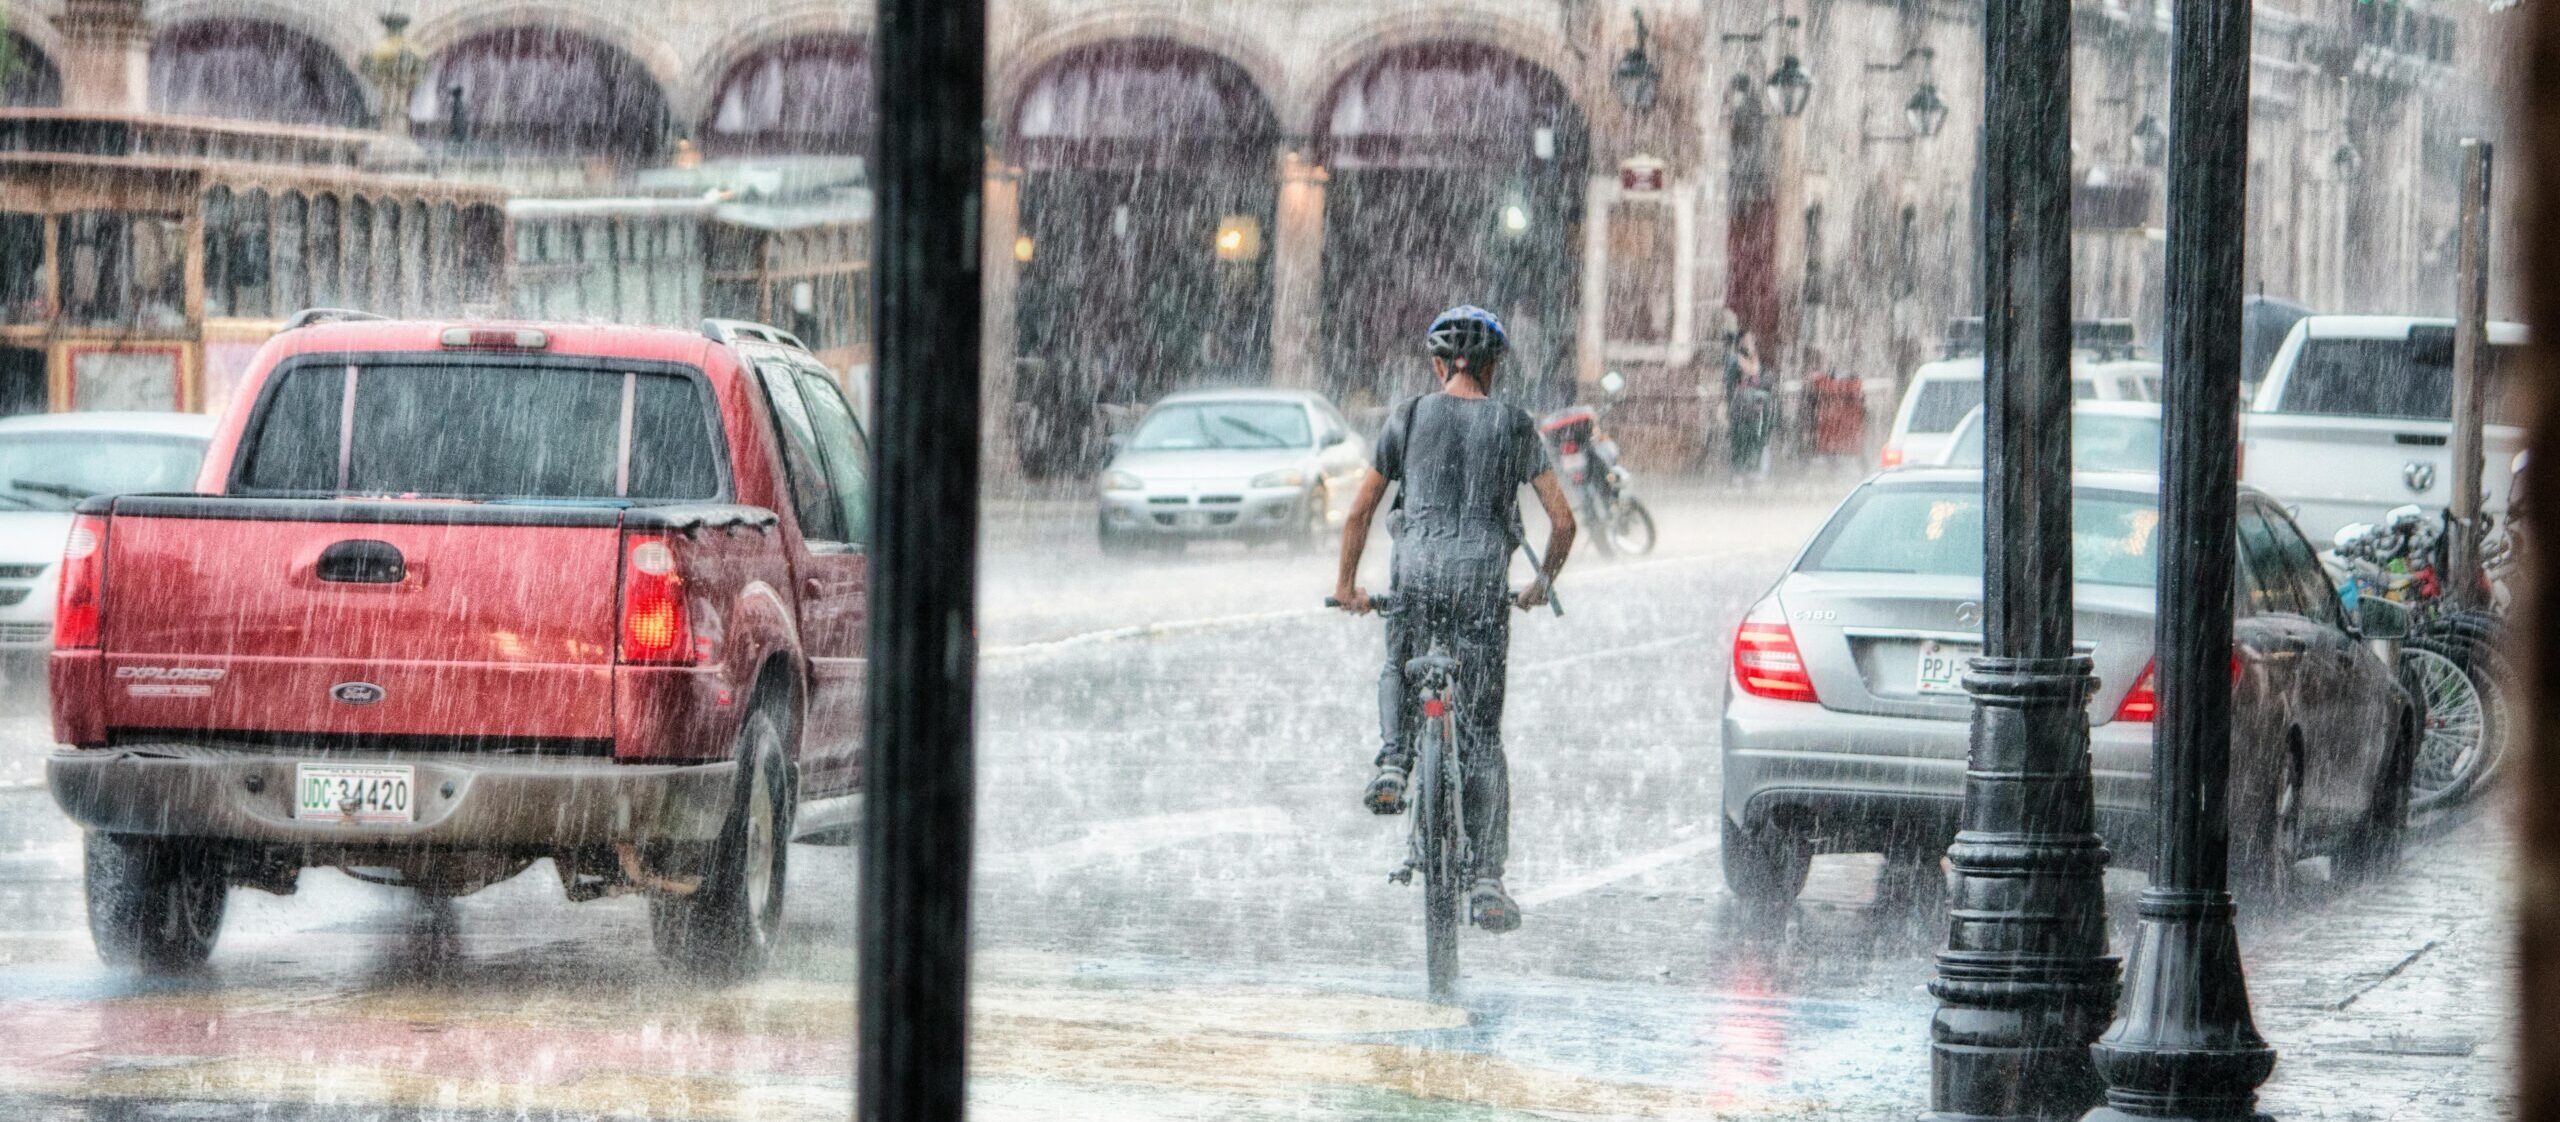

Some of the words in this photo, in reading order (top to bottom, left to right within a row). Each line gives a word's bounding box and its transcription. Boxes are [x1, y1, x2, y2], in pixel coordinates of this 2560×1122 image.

[115, 666, 225, 680] EXPLORER
[1922, 658, 1964, 679] PPJ-
[302, 778, 407, 811] UDC-34420
